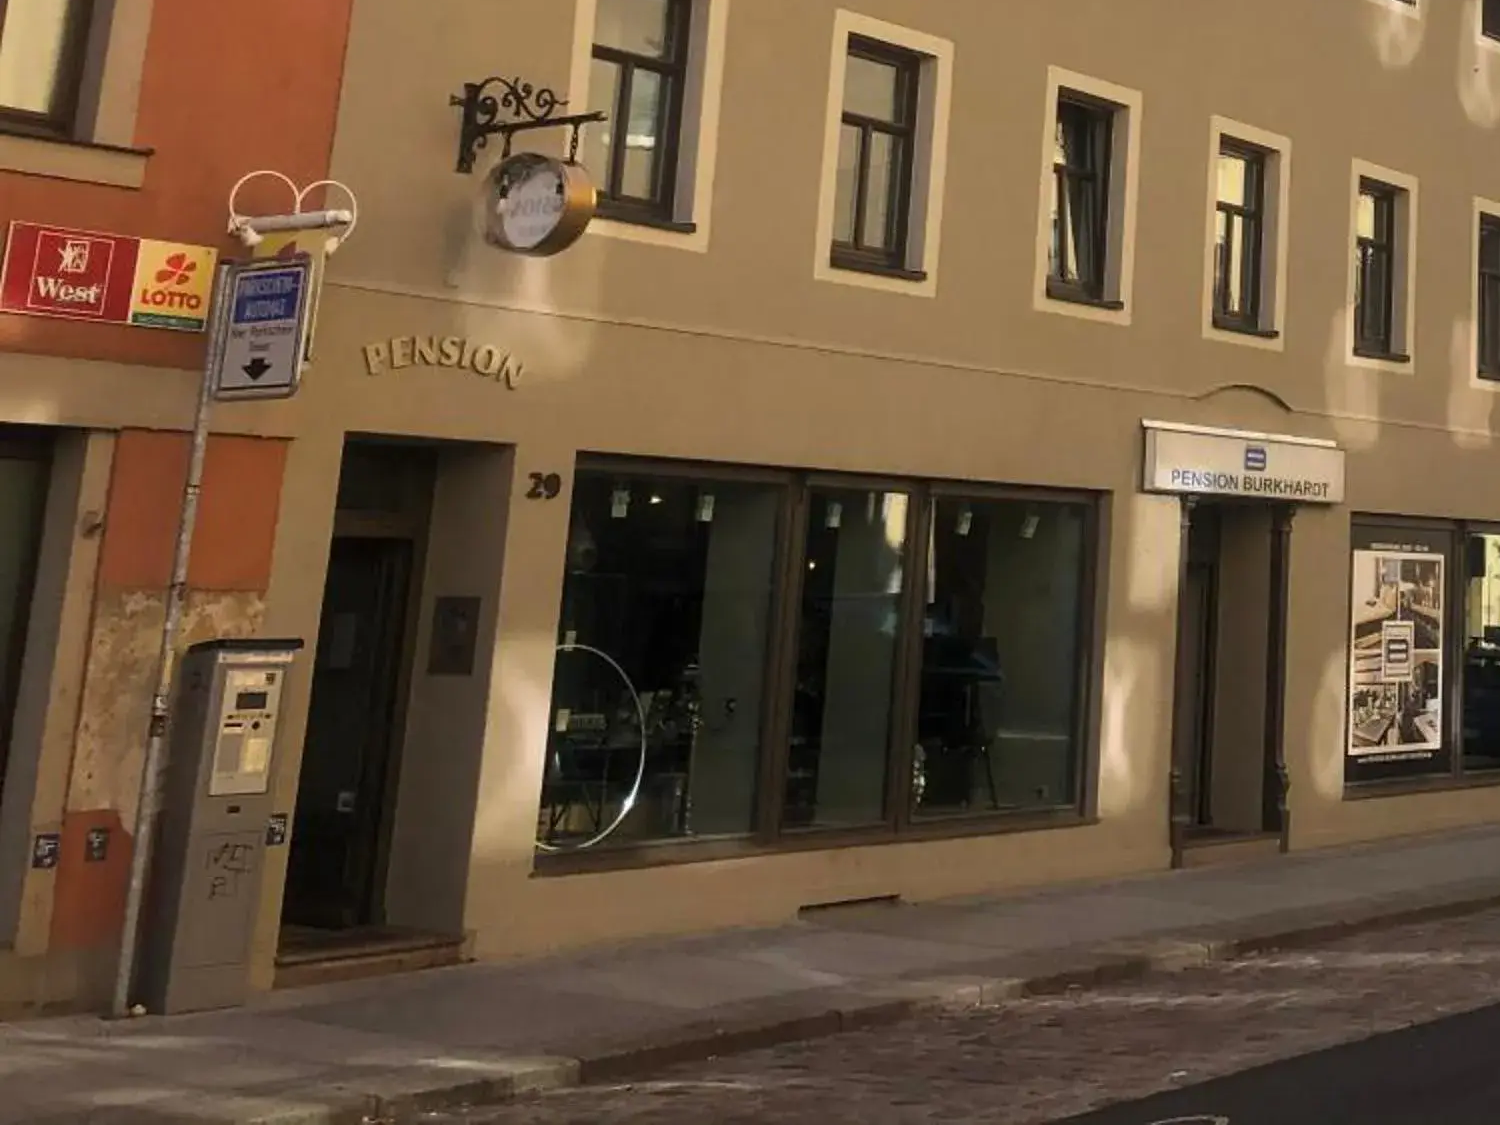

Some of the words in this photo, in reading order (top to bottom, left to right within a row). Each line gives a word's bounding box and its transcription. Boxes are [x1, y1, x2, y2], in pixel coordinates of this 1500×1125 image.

[36, 276, 101, 304] West
[140, 288, 201, 310] LOTTO
[362, 334, 525, 391] PENSION
[525, 472, 562, 500] 29
[1171, 469, 1239, 491] PENSION
[1243, 476, 1329, 499] BURKHARDT
